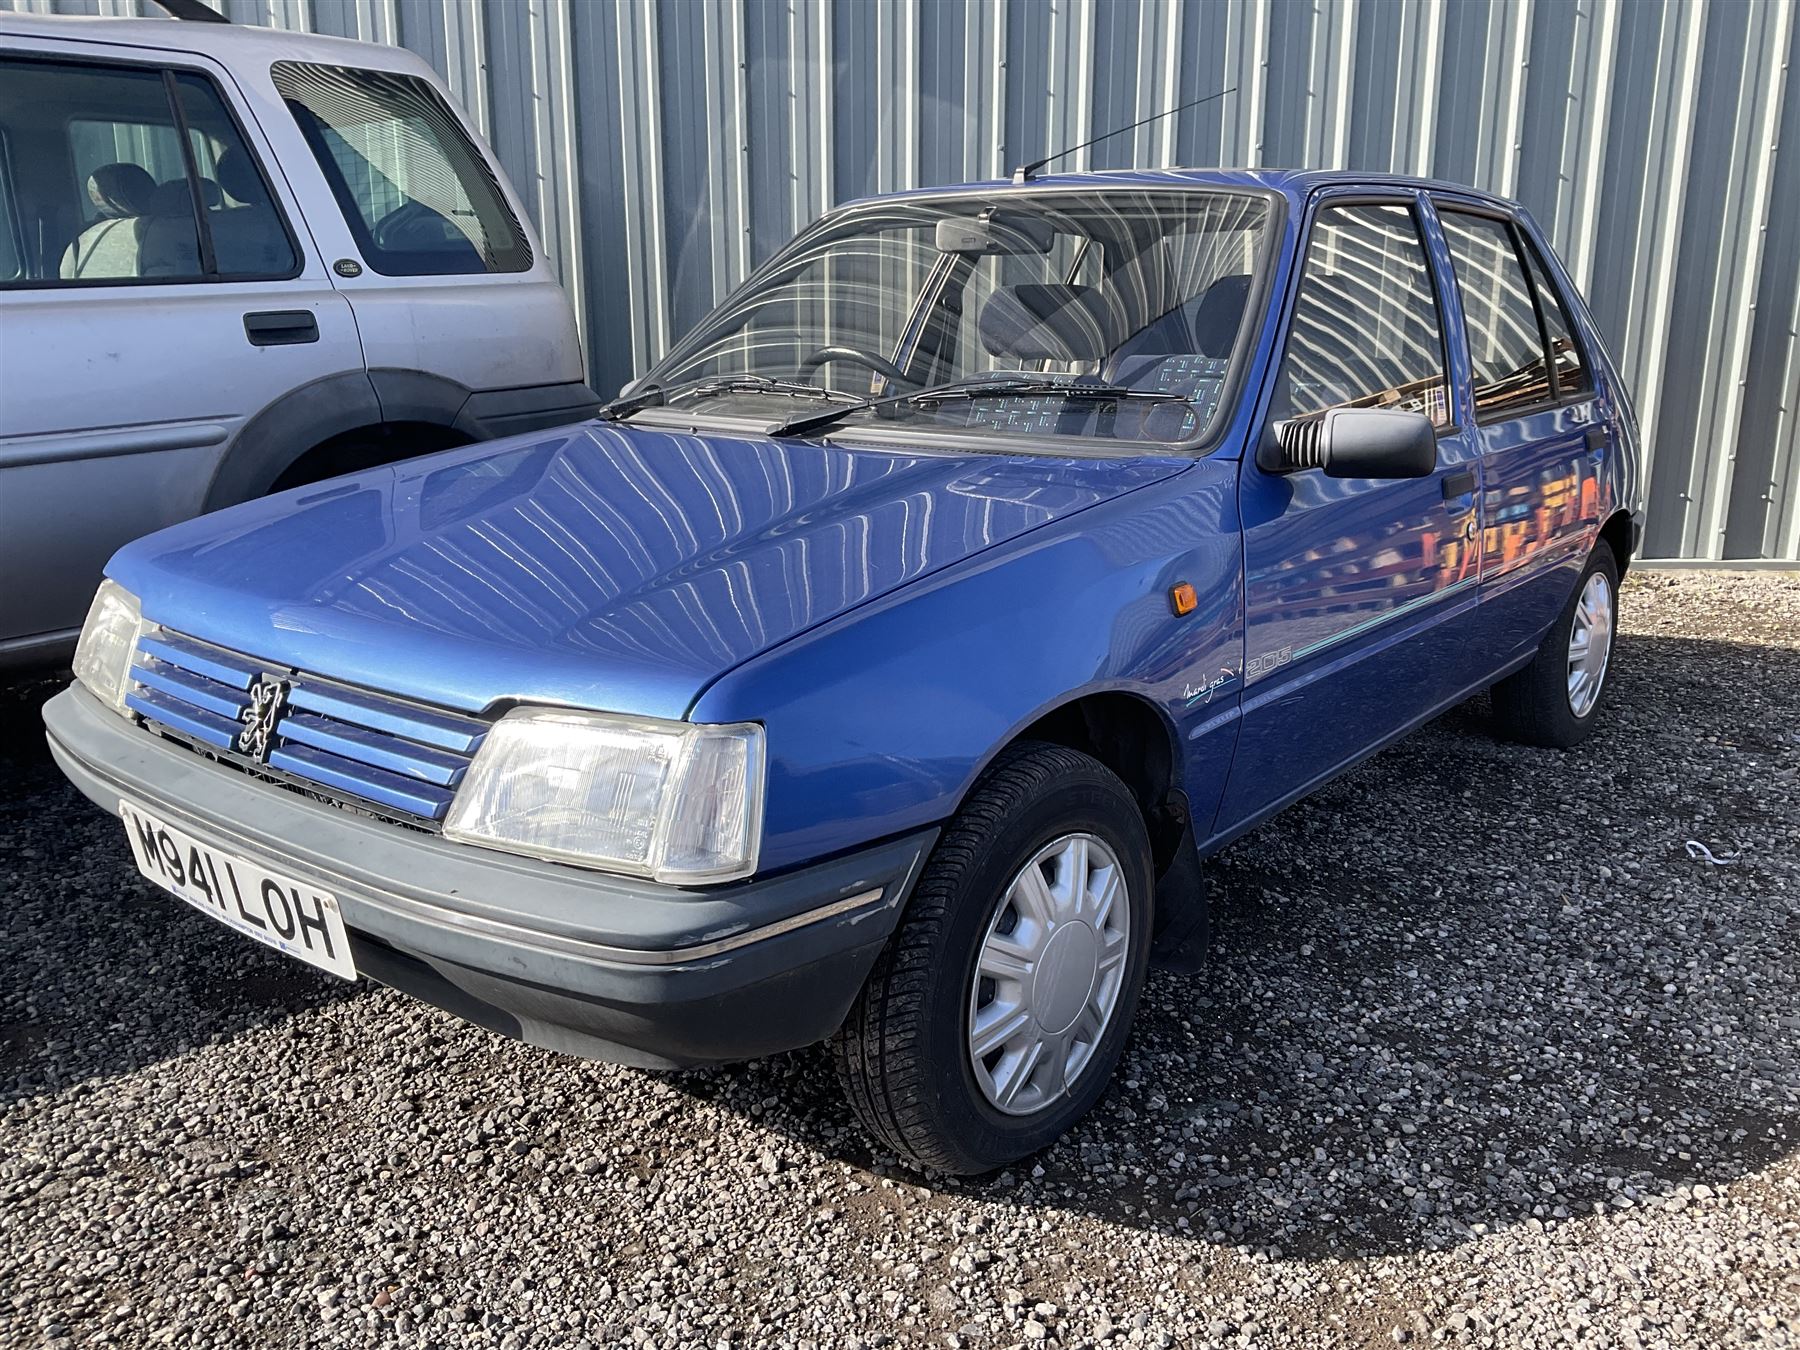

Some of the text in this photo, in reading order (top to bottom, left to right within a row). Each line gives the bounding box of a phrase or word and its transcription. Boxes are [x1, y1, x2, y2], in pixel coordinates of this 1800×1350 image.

[1246, 645, 1292, 679] 205
[132, 812, 227, 911] M941
[224, 861, 336, 960] LOH
